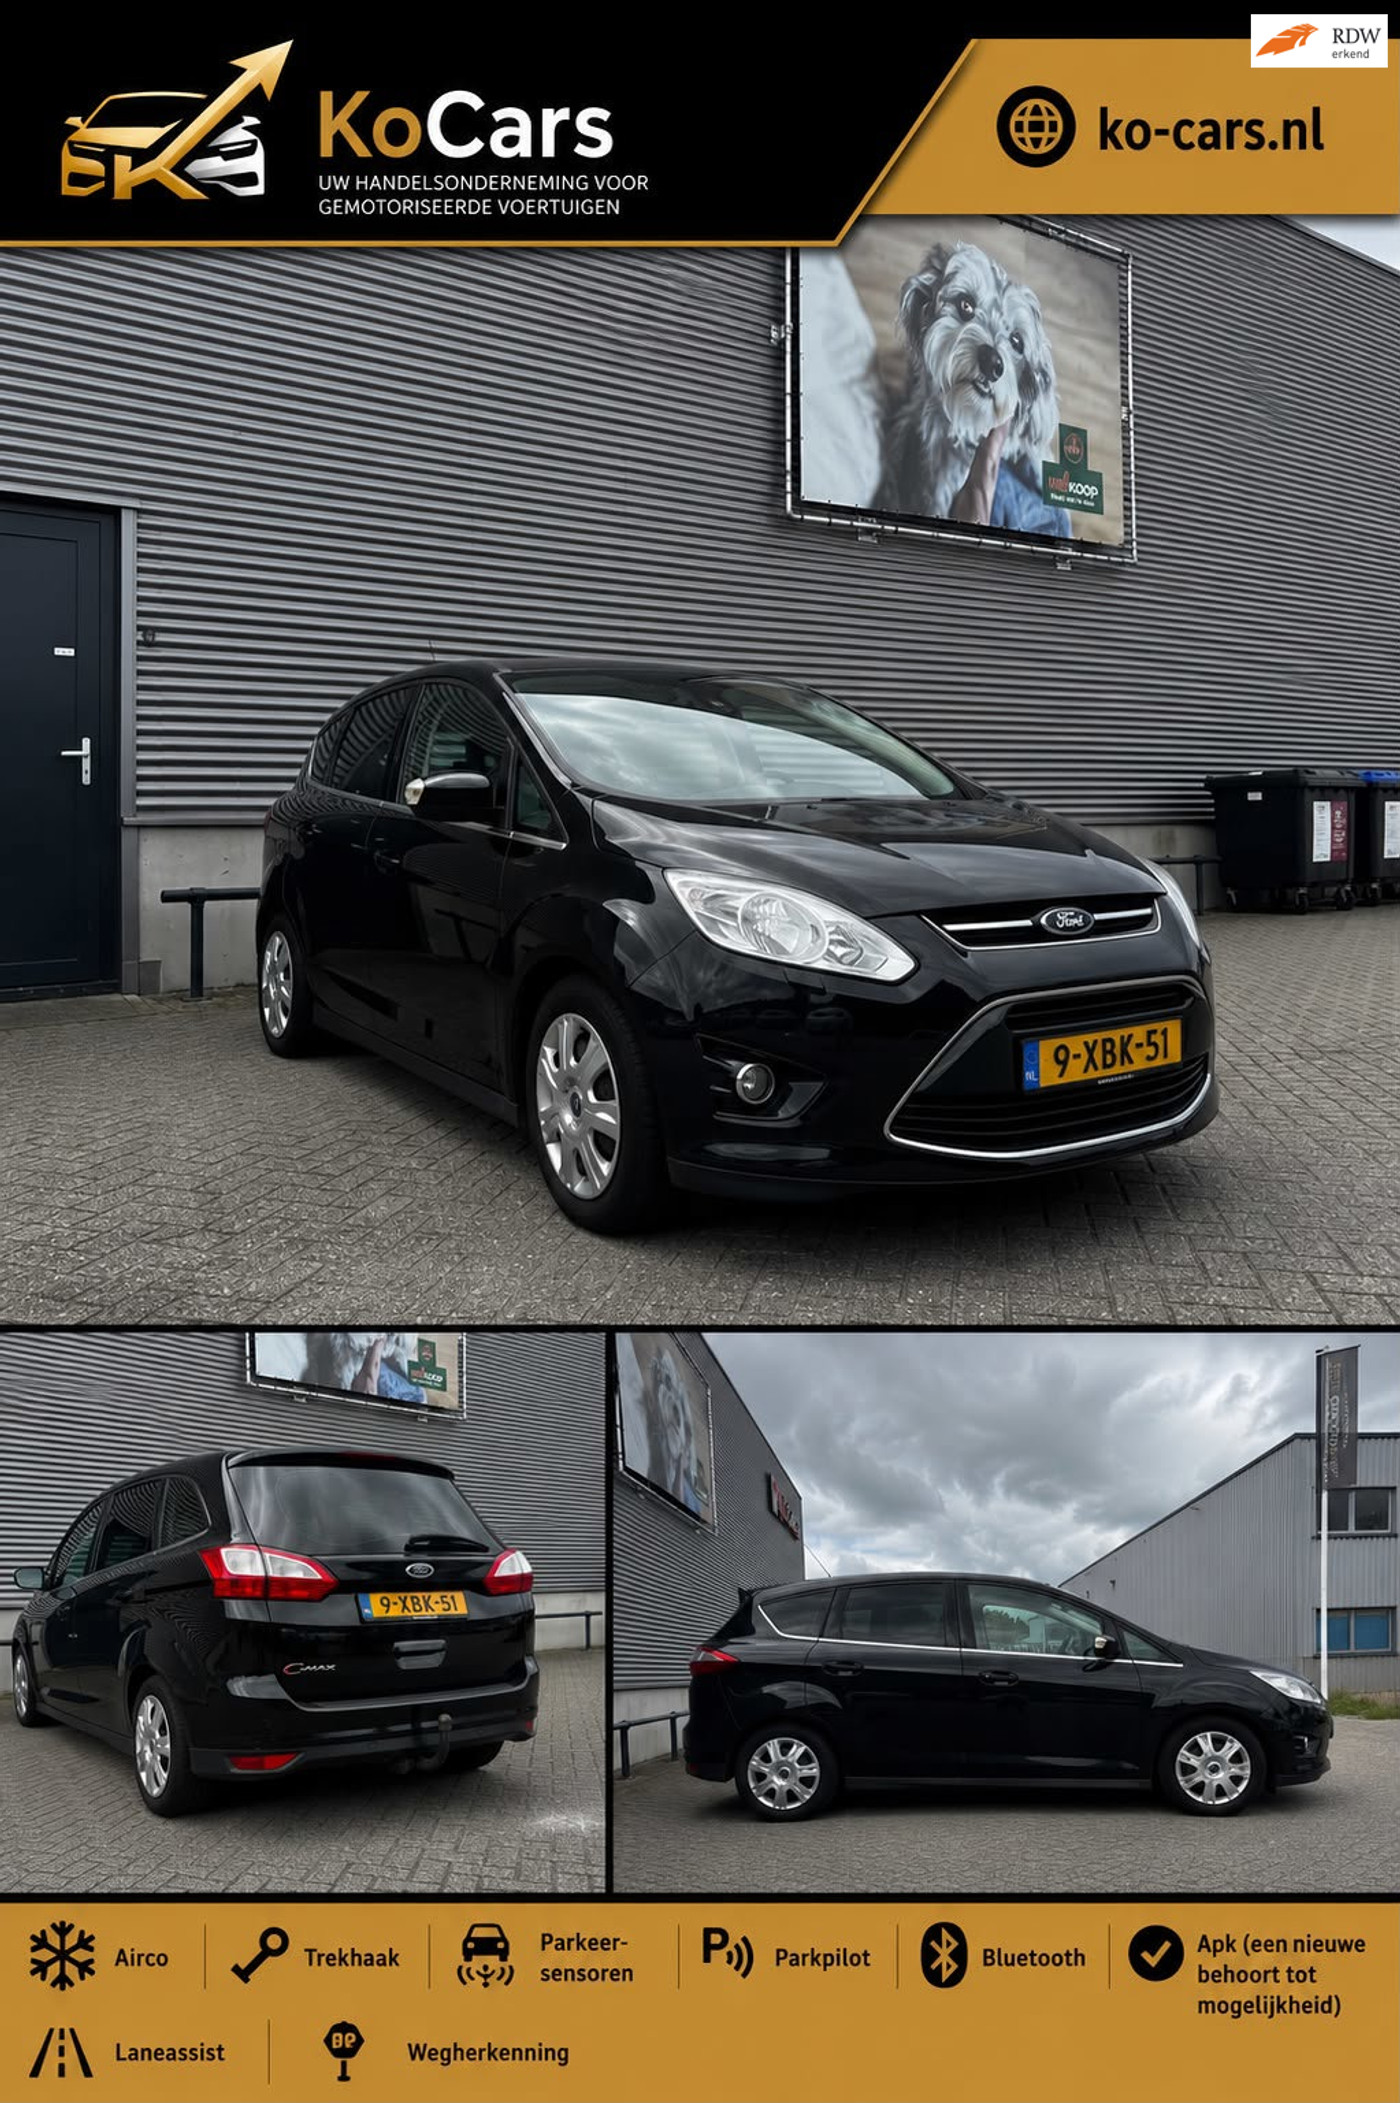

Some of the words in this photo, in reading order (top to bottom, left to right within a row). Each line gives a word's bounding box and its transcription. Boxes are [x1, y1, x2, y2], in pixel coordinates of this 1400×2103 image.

[1056, 911, 1085, 928] Ford
[1053, 1027, 1169, 1078] 9-XBK-51
[380, 1594, 459, 1614] 9-XBK-51
